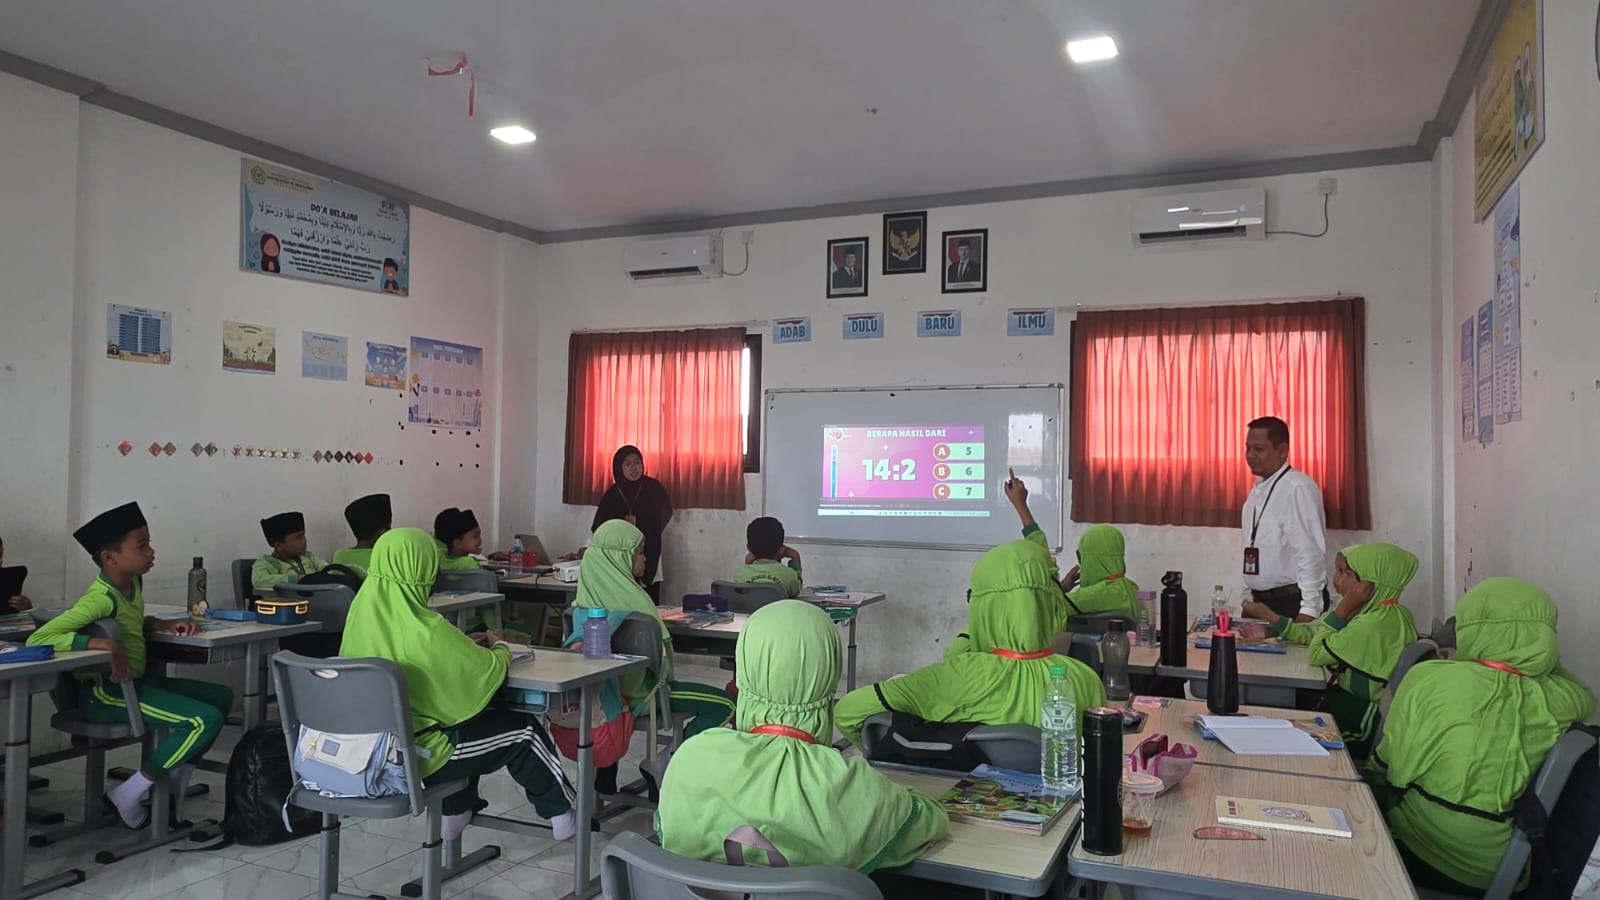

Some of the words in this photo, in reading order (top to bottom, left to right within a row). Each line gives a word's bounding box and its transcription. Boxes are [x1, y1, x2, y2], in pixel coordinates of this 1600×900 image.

[310, 203, 328, 215] DO'A
[329, 207, 359, 222] BELAJAR
[851, 318, 878, 333] DULU
[925, 316, 955, 331] BARU
[1017, 315, 1046, 329] ILMU
[779, 325, 806, 339] ADAB
[866, 429, 898, 438] BERAPA
[899, 429, 925, 438] HASIL
[925, 429, 947, 437] DARI
[965, 447, 972, 456] 5
[861, 458, 916, 481] 14:2
[965, 467, 972, 476] 6
[965, 487, 972, 496] 7
